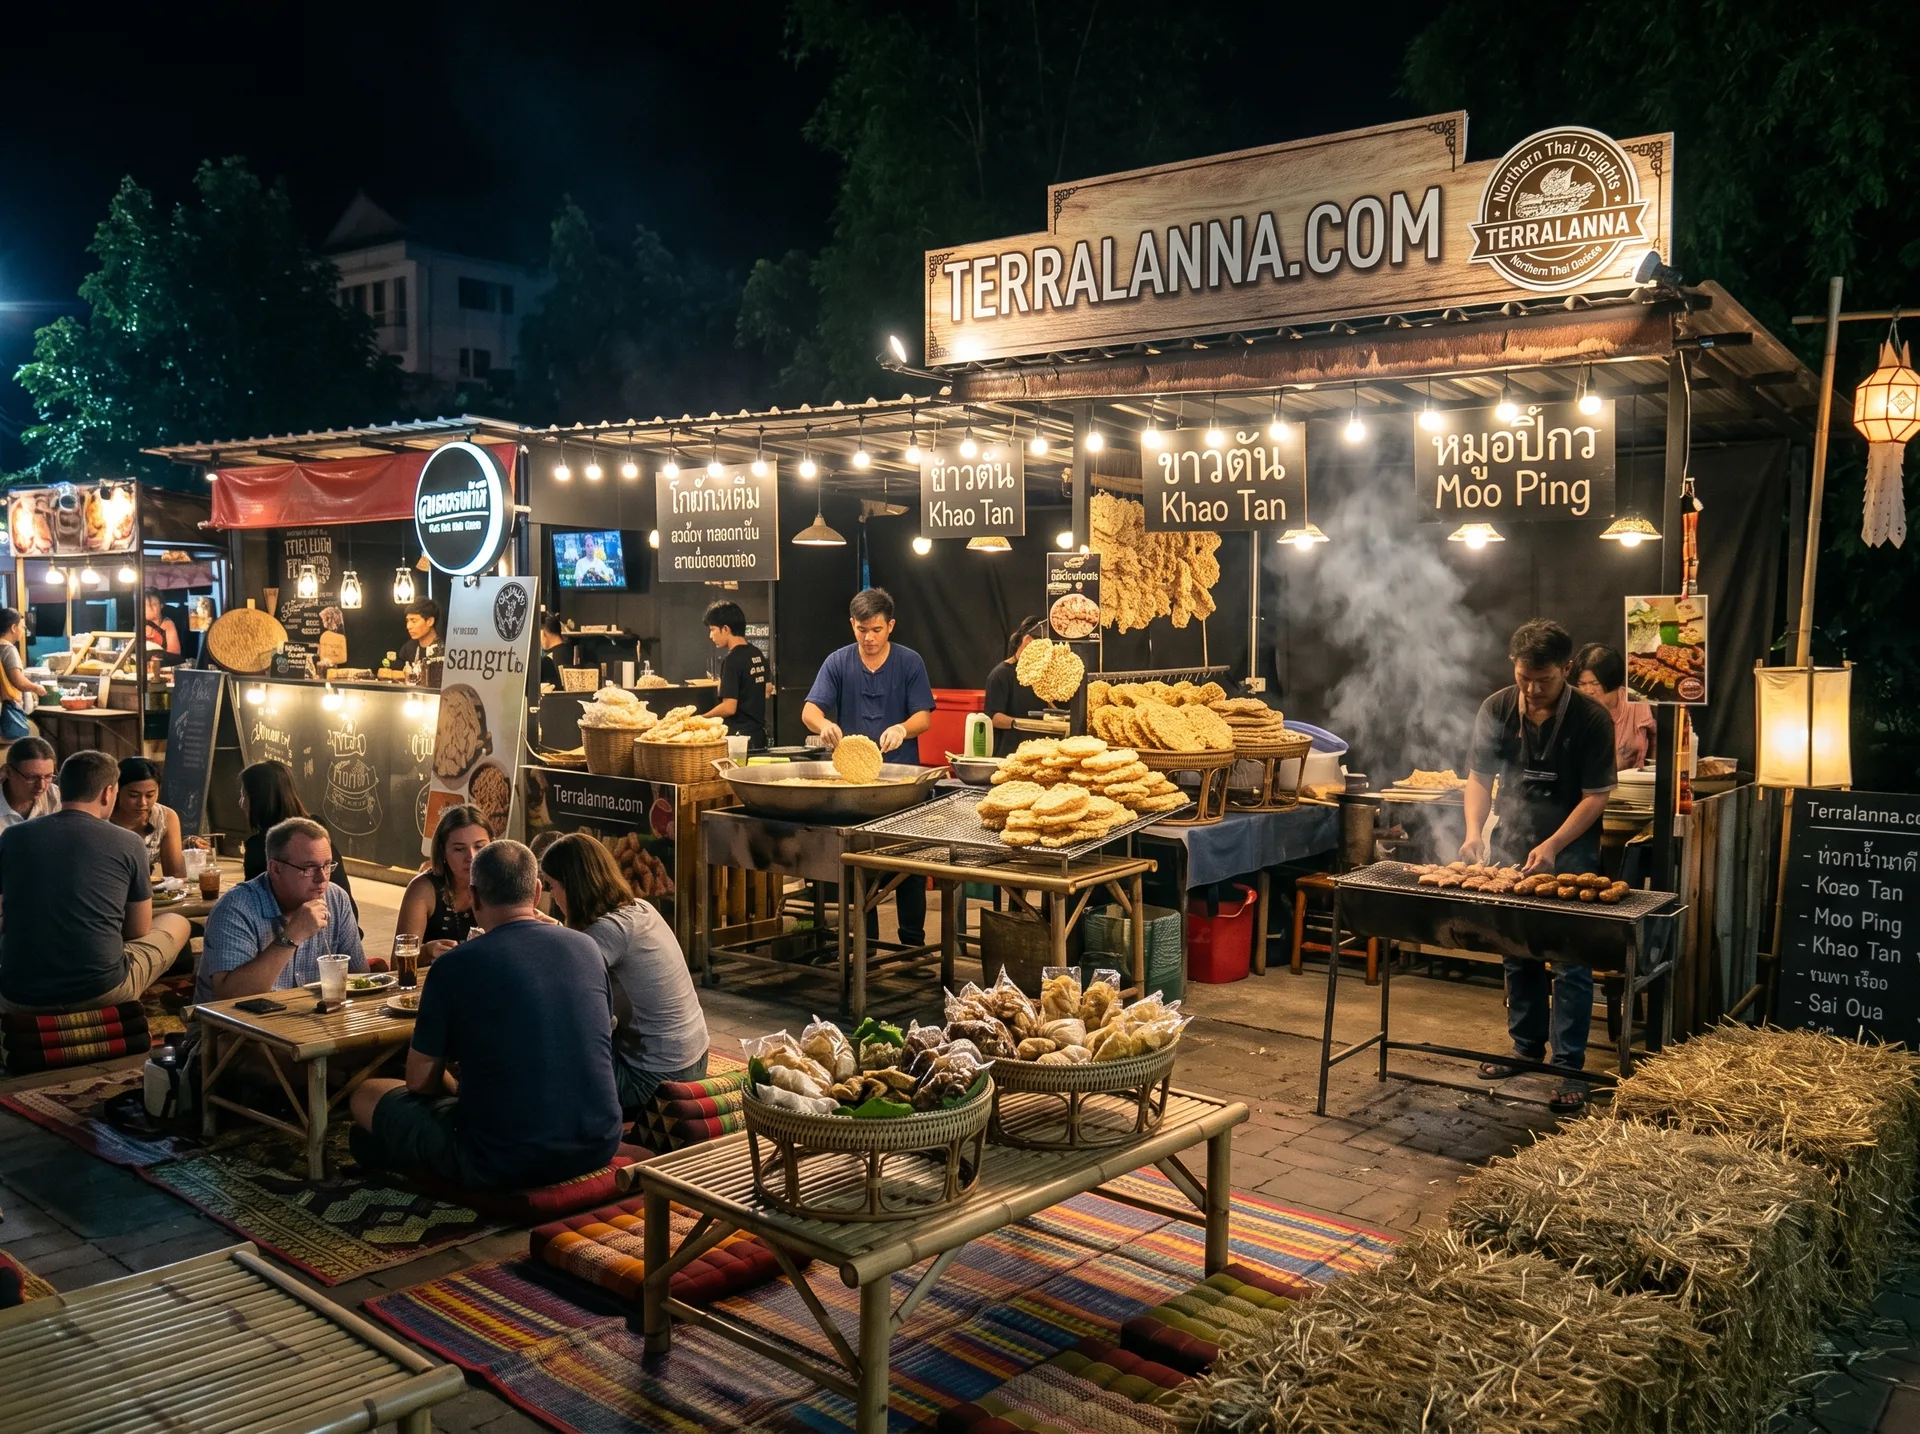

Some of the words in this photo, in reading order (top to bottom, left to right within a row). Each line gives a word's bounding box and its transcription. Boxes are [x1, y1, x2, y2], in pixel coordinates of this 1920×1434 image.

[1493, 149, 1543, 203] Northern
[1545, 140, 1578, 157] Thai
[1578, 142, 1622, 191] Delights
[1485, 211, 1630, 251] TERRALANNA
[943, 186, 1441, 322] TERRALANNA.COM
[1550, 263, 1570, 276] Thai
[1162, 490, 1229, 523] Khao
[1236, 489, 1286, 521] Tan
[1435, 473, 1502, 509] Moo
[1516, 469, 1591, 516] Ping
[929, 501, 976, 527] Khao
[980, 498, 1014, 525] Tan
[553, 784, 643, 814] Terralanna.com
[1868, 879, 1903, 901] Tan
[1814, 906, 1853, 929] Moo
[1861, 911, 1902, 939] Ping
[1813, 935, 1858, 958] Khao
[1867, 941, 1901, 963] Tan
[1809, 993, 1837, 1014] Sai
[1846, 998, 1883, 1020] Oua
